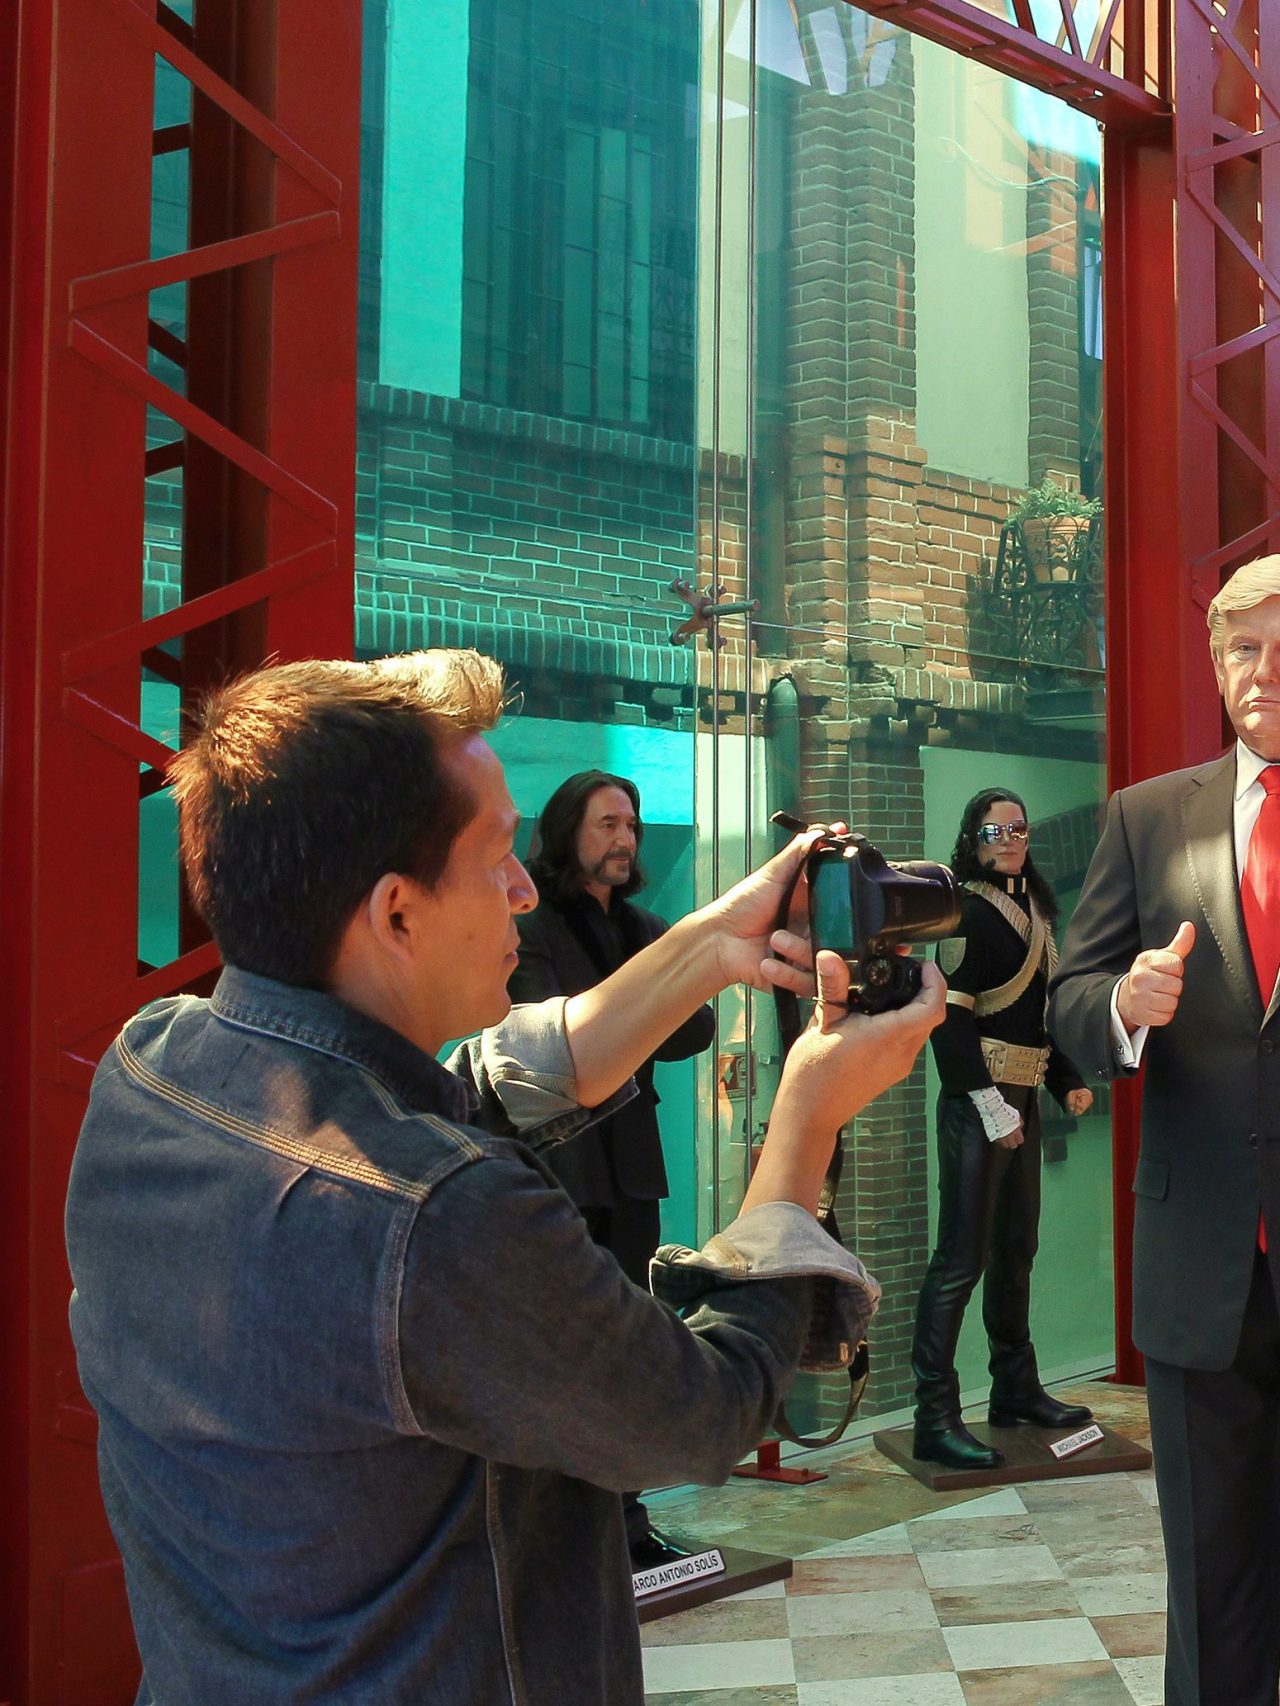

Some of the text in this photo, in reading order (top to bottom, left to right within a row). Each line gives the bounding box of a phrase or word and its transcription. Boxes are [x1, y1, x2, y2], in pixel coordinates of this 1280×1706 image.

[633, 1553, 719, 1592] ARCO ANTONIO SOLÍS
